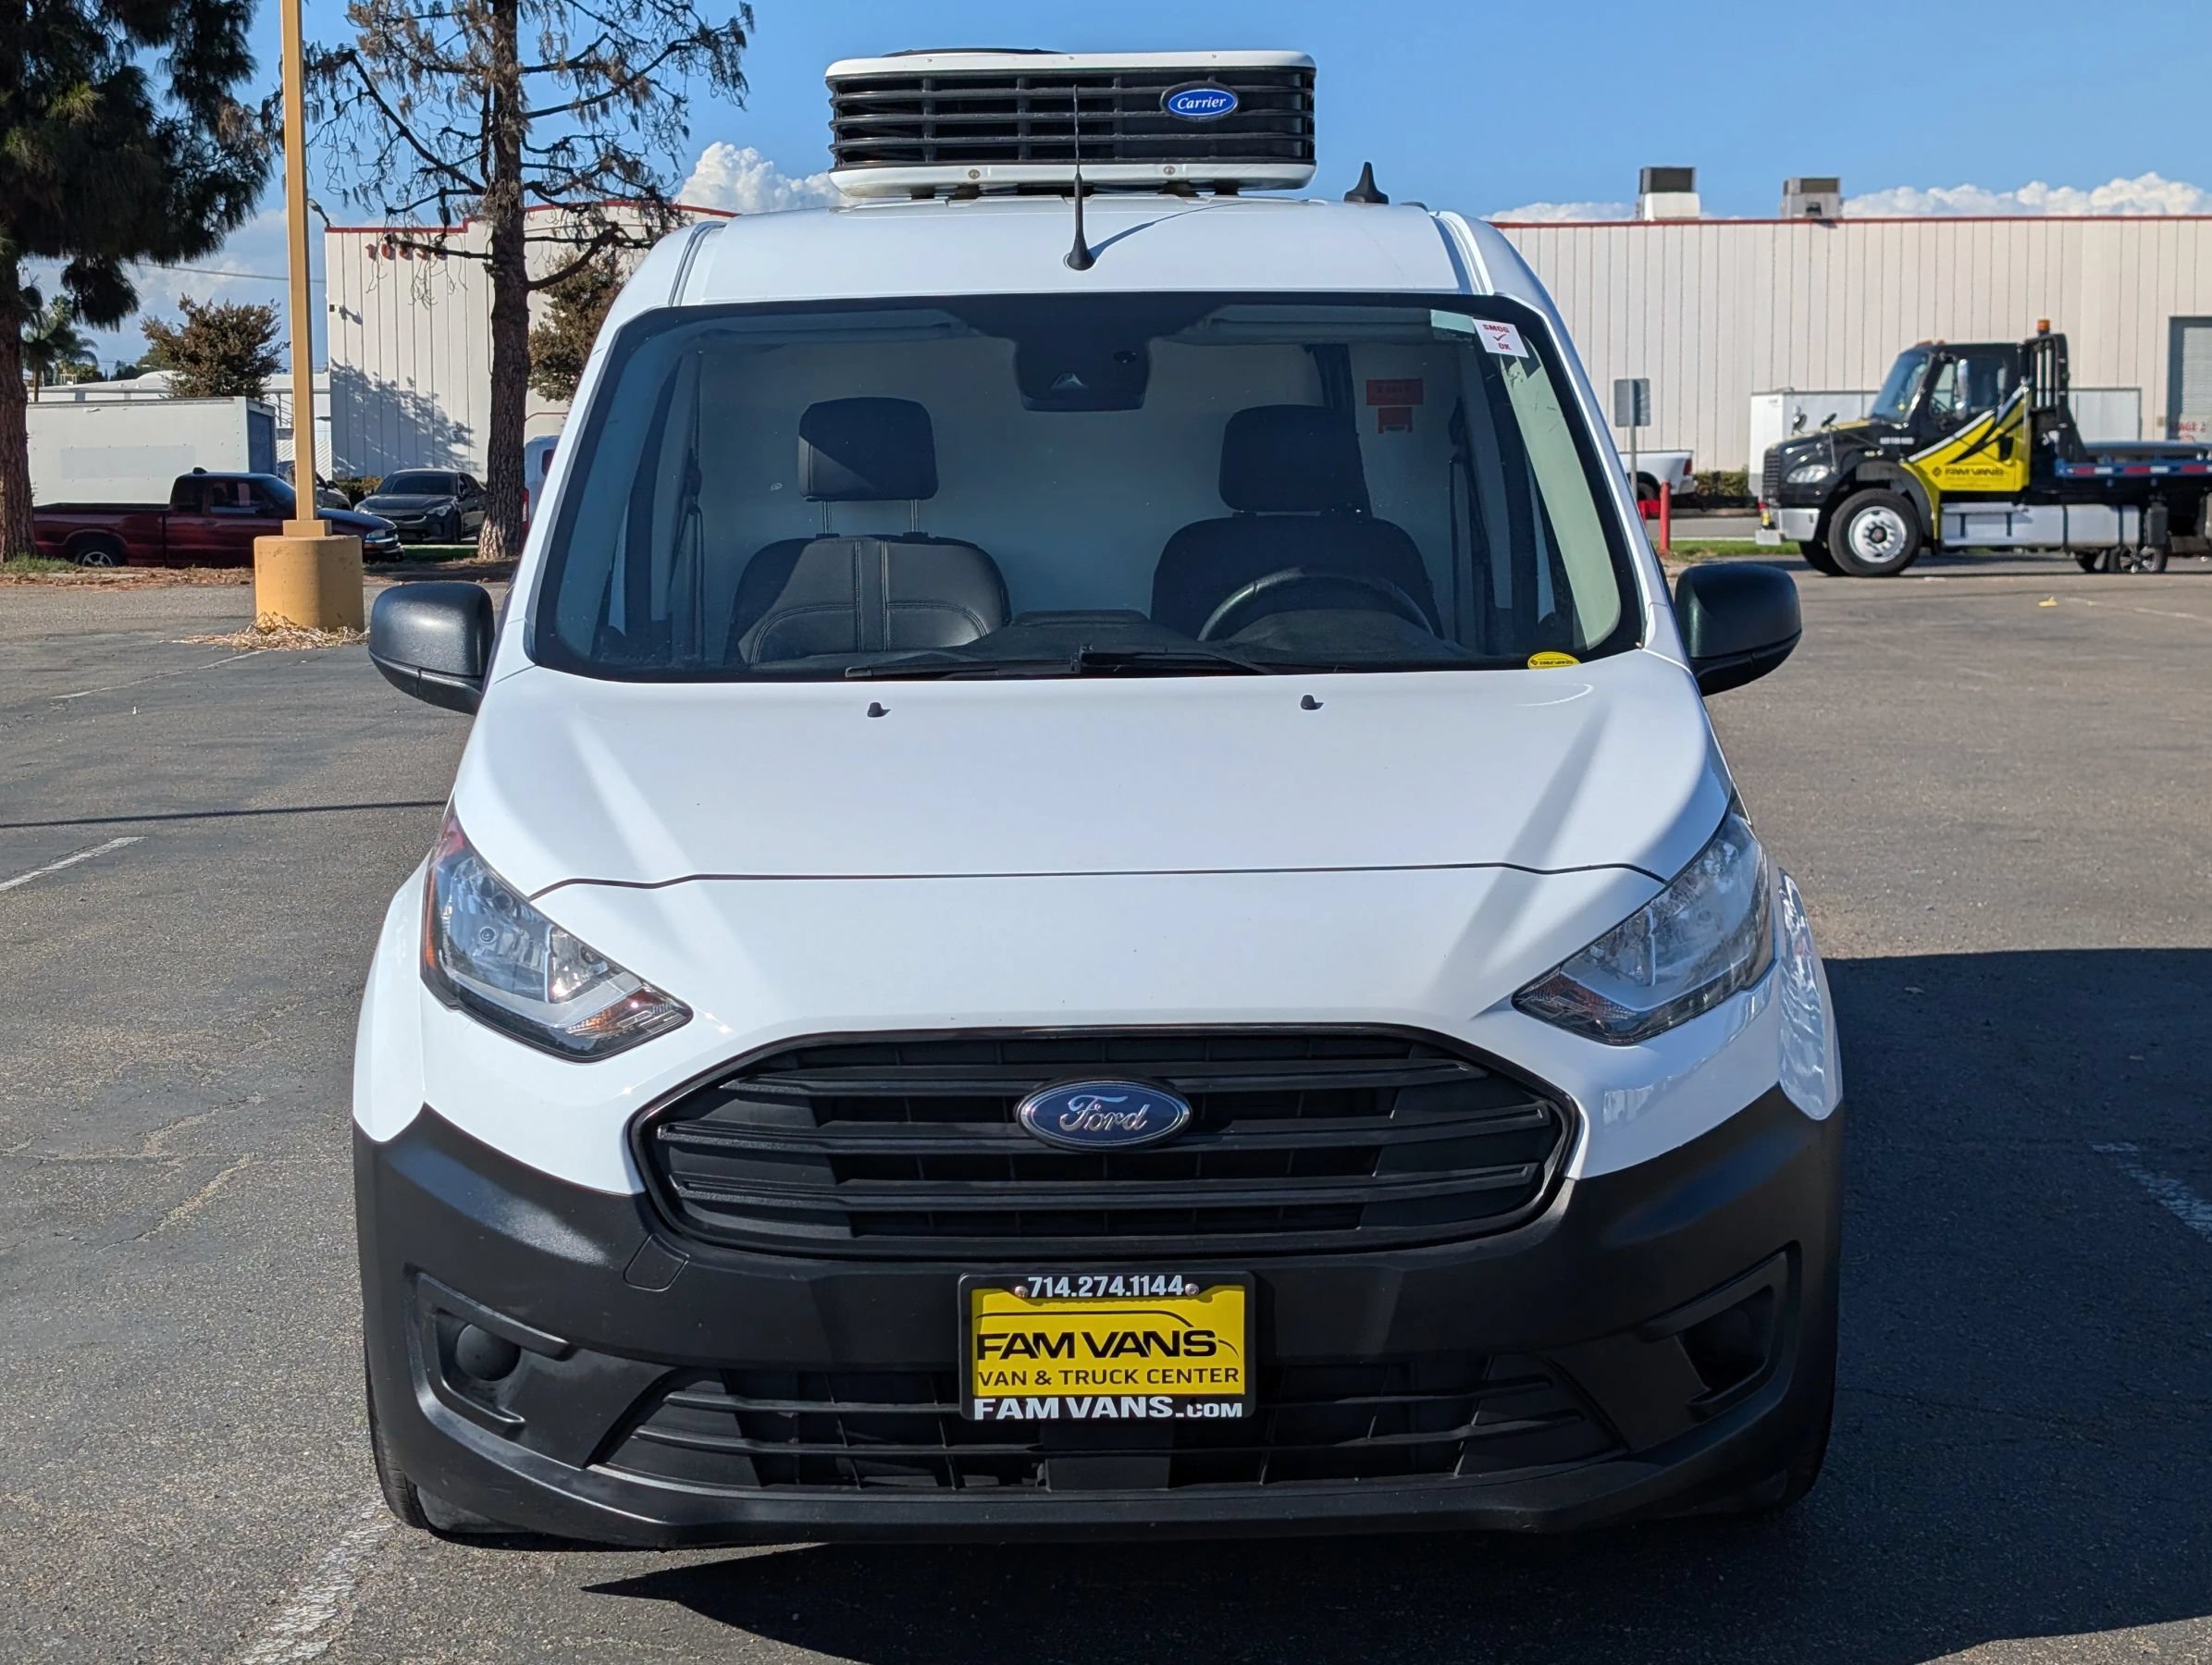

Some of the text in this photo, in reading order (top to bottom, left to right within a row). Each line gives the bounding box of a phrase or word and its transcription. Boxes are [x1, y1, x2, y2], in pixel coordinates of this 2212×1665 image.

[1178, 97, 1226, 109] Carrier
[1059, 1094, 1150, 1131] Ford
[1028, 1276, 1183, 1298] 714.274.1144
[978, 1367, 1239, 1387] VAN & TRUCK CENTER
